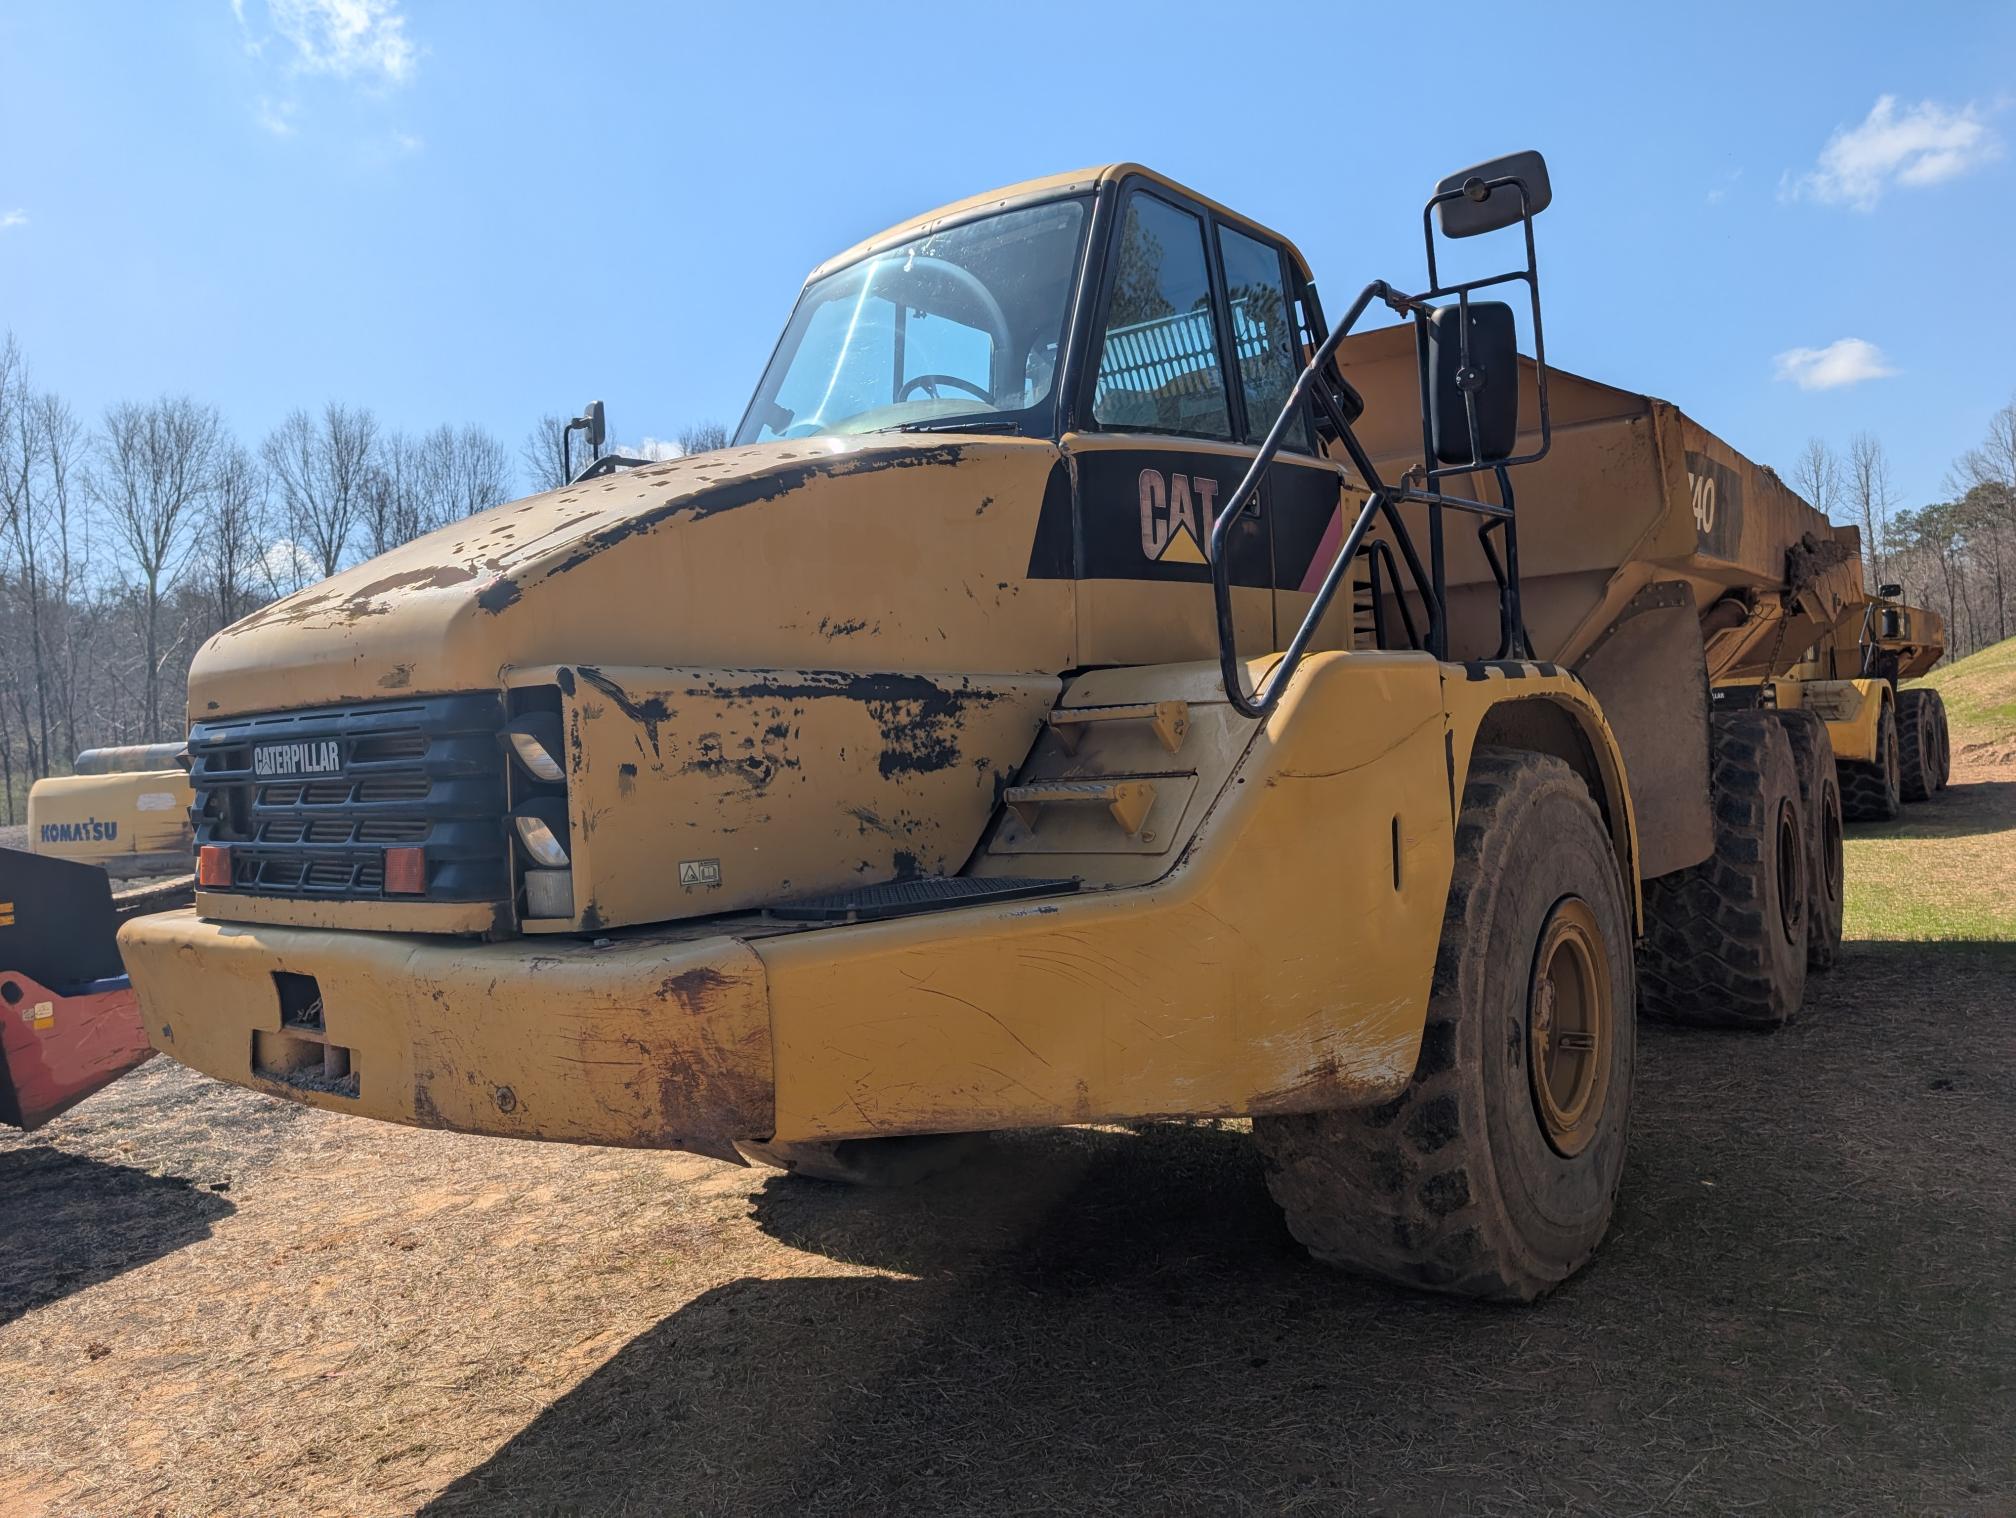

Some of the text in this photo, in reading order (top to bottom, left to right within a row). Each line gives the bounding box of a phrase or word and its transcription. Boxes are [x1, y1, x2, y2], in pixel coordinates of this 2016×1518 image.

[1139, 468, 1218, 566] CAT
[254, 741, 340, 775] CATERPILLAR
[41, 816, 117, 842] KOMATSU
